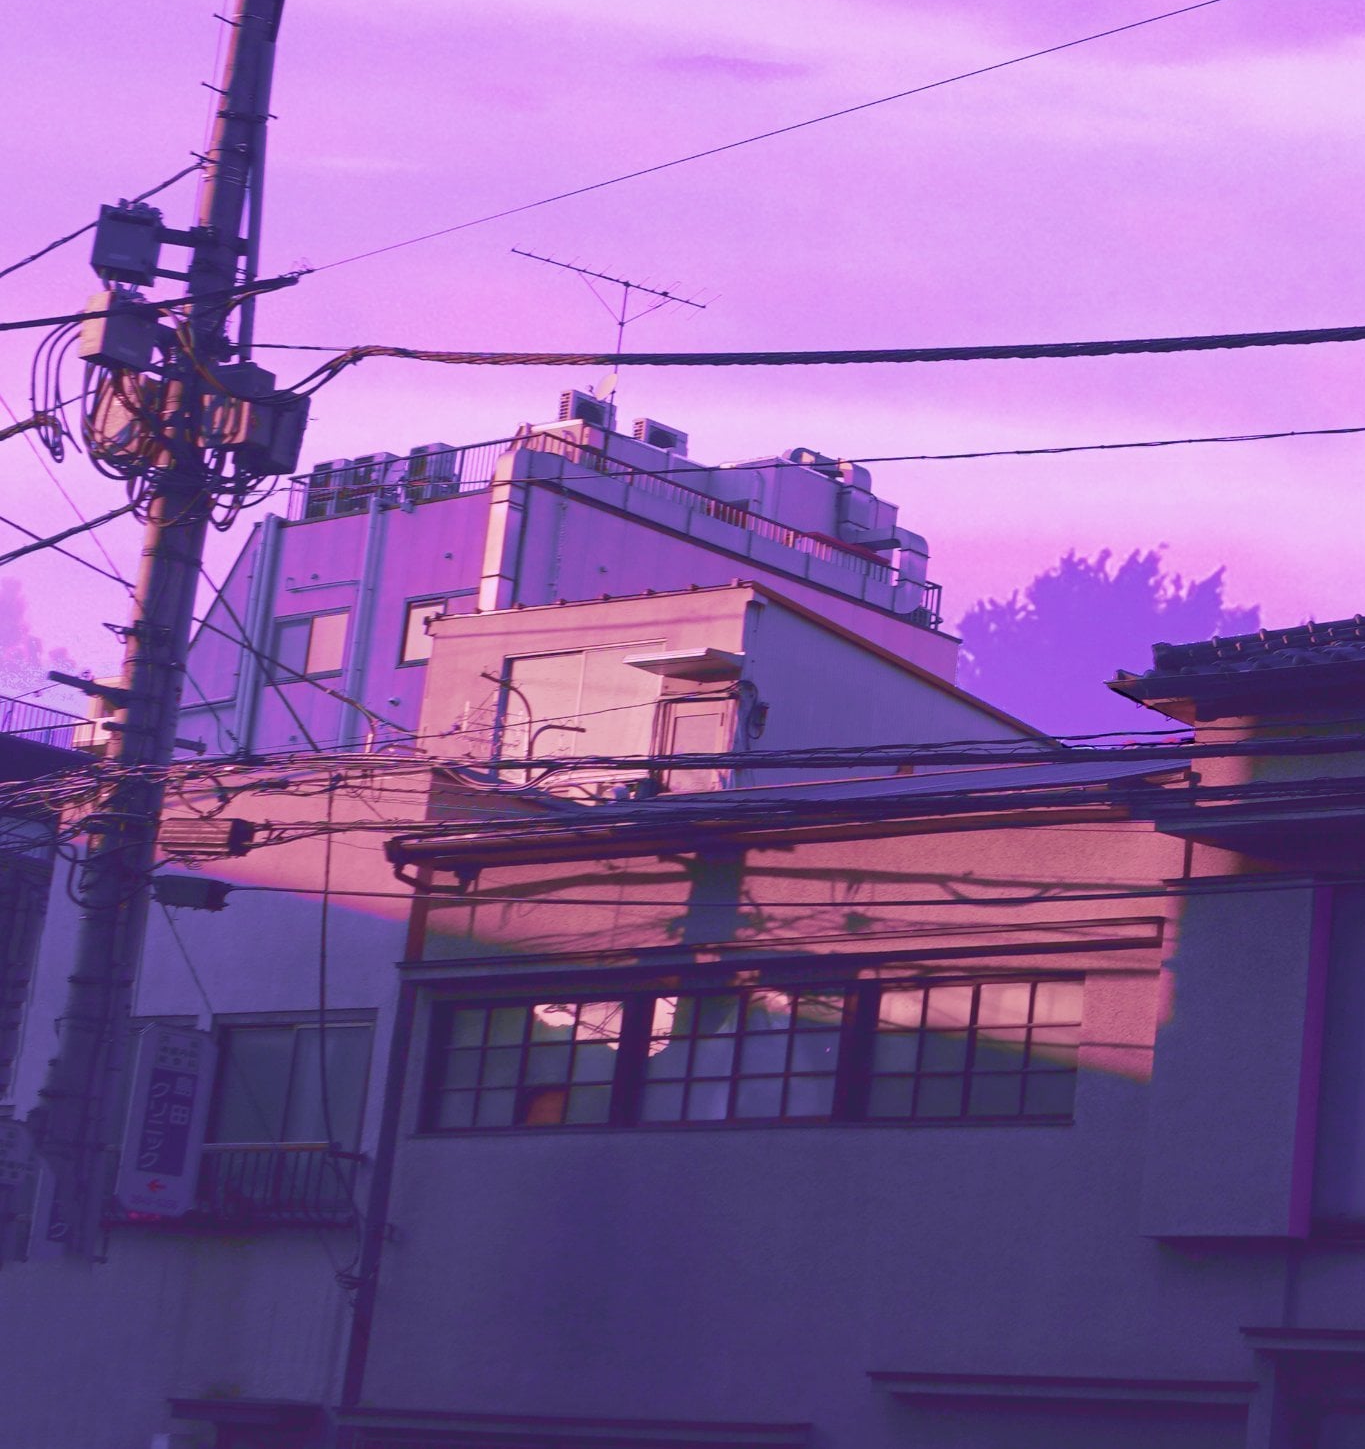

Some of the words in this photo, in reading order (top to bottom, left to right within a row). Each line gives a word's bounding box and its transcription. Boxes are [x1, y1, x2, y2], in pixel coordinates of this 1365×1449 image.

[139, 1082, 171, 1168] クリニック
